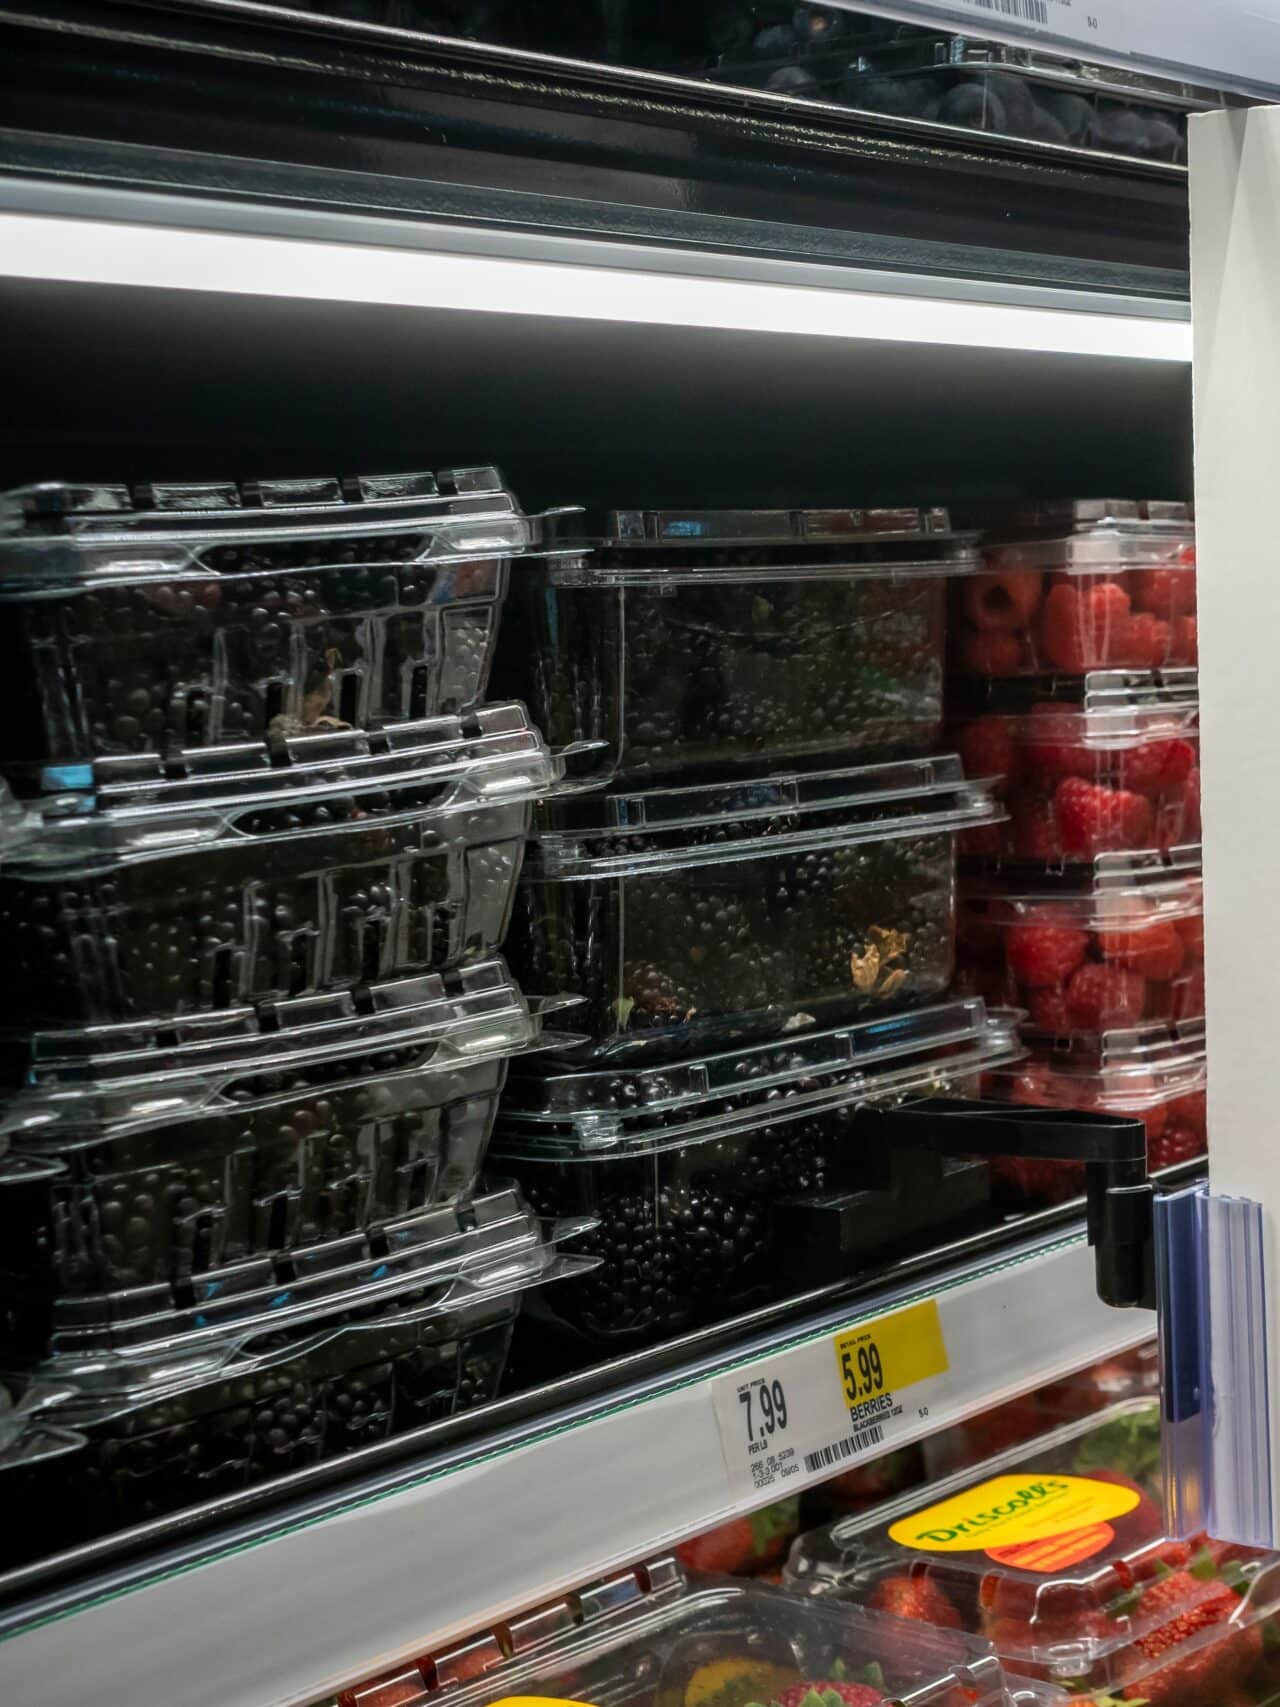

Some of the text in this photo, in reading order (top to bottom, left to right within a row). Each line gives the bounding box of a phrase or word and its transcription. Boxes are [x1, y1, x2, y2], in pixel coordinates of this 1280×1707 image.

[842, 1342, 883, 1401] 5.99
[739, 1379, 787, 1442] 7.99
[850, 1392, 893, 1422] BERRIES
[916, 1479, 1069, 1543] Driscoll's
